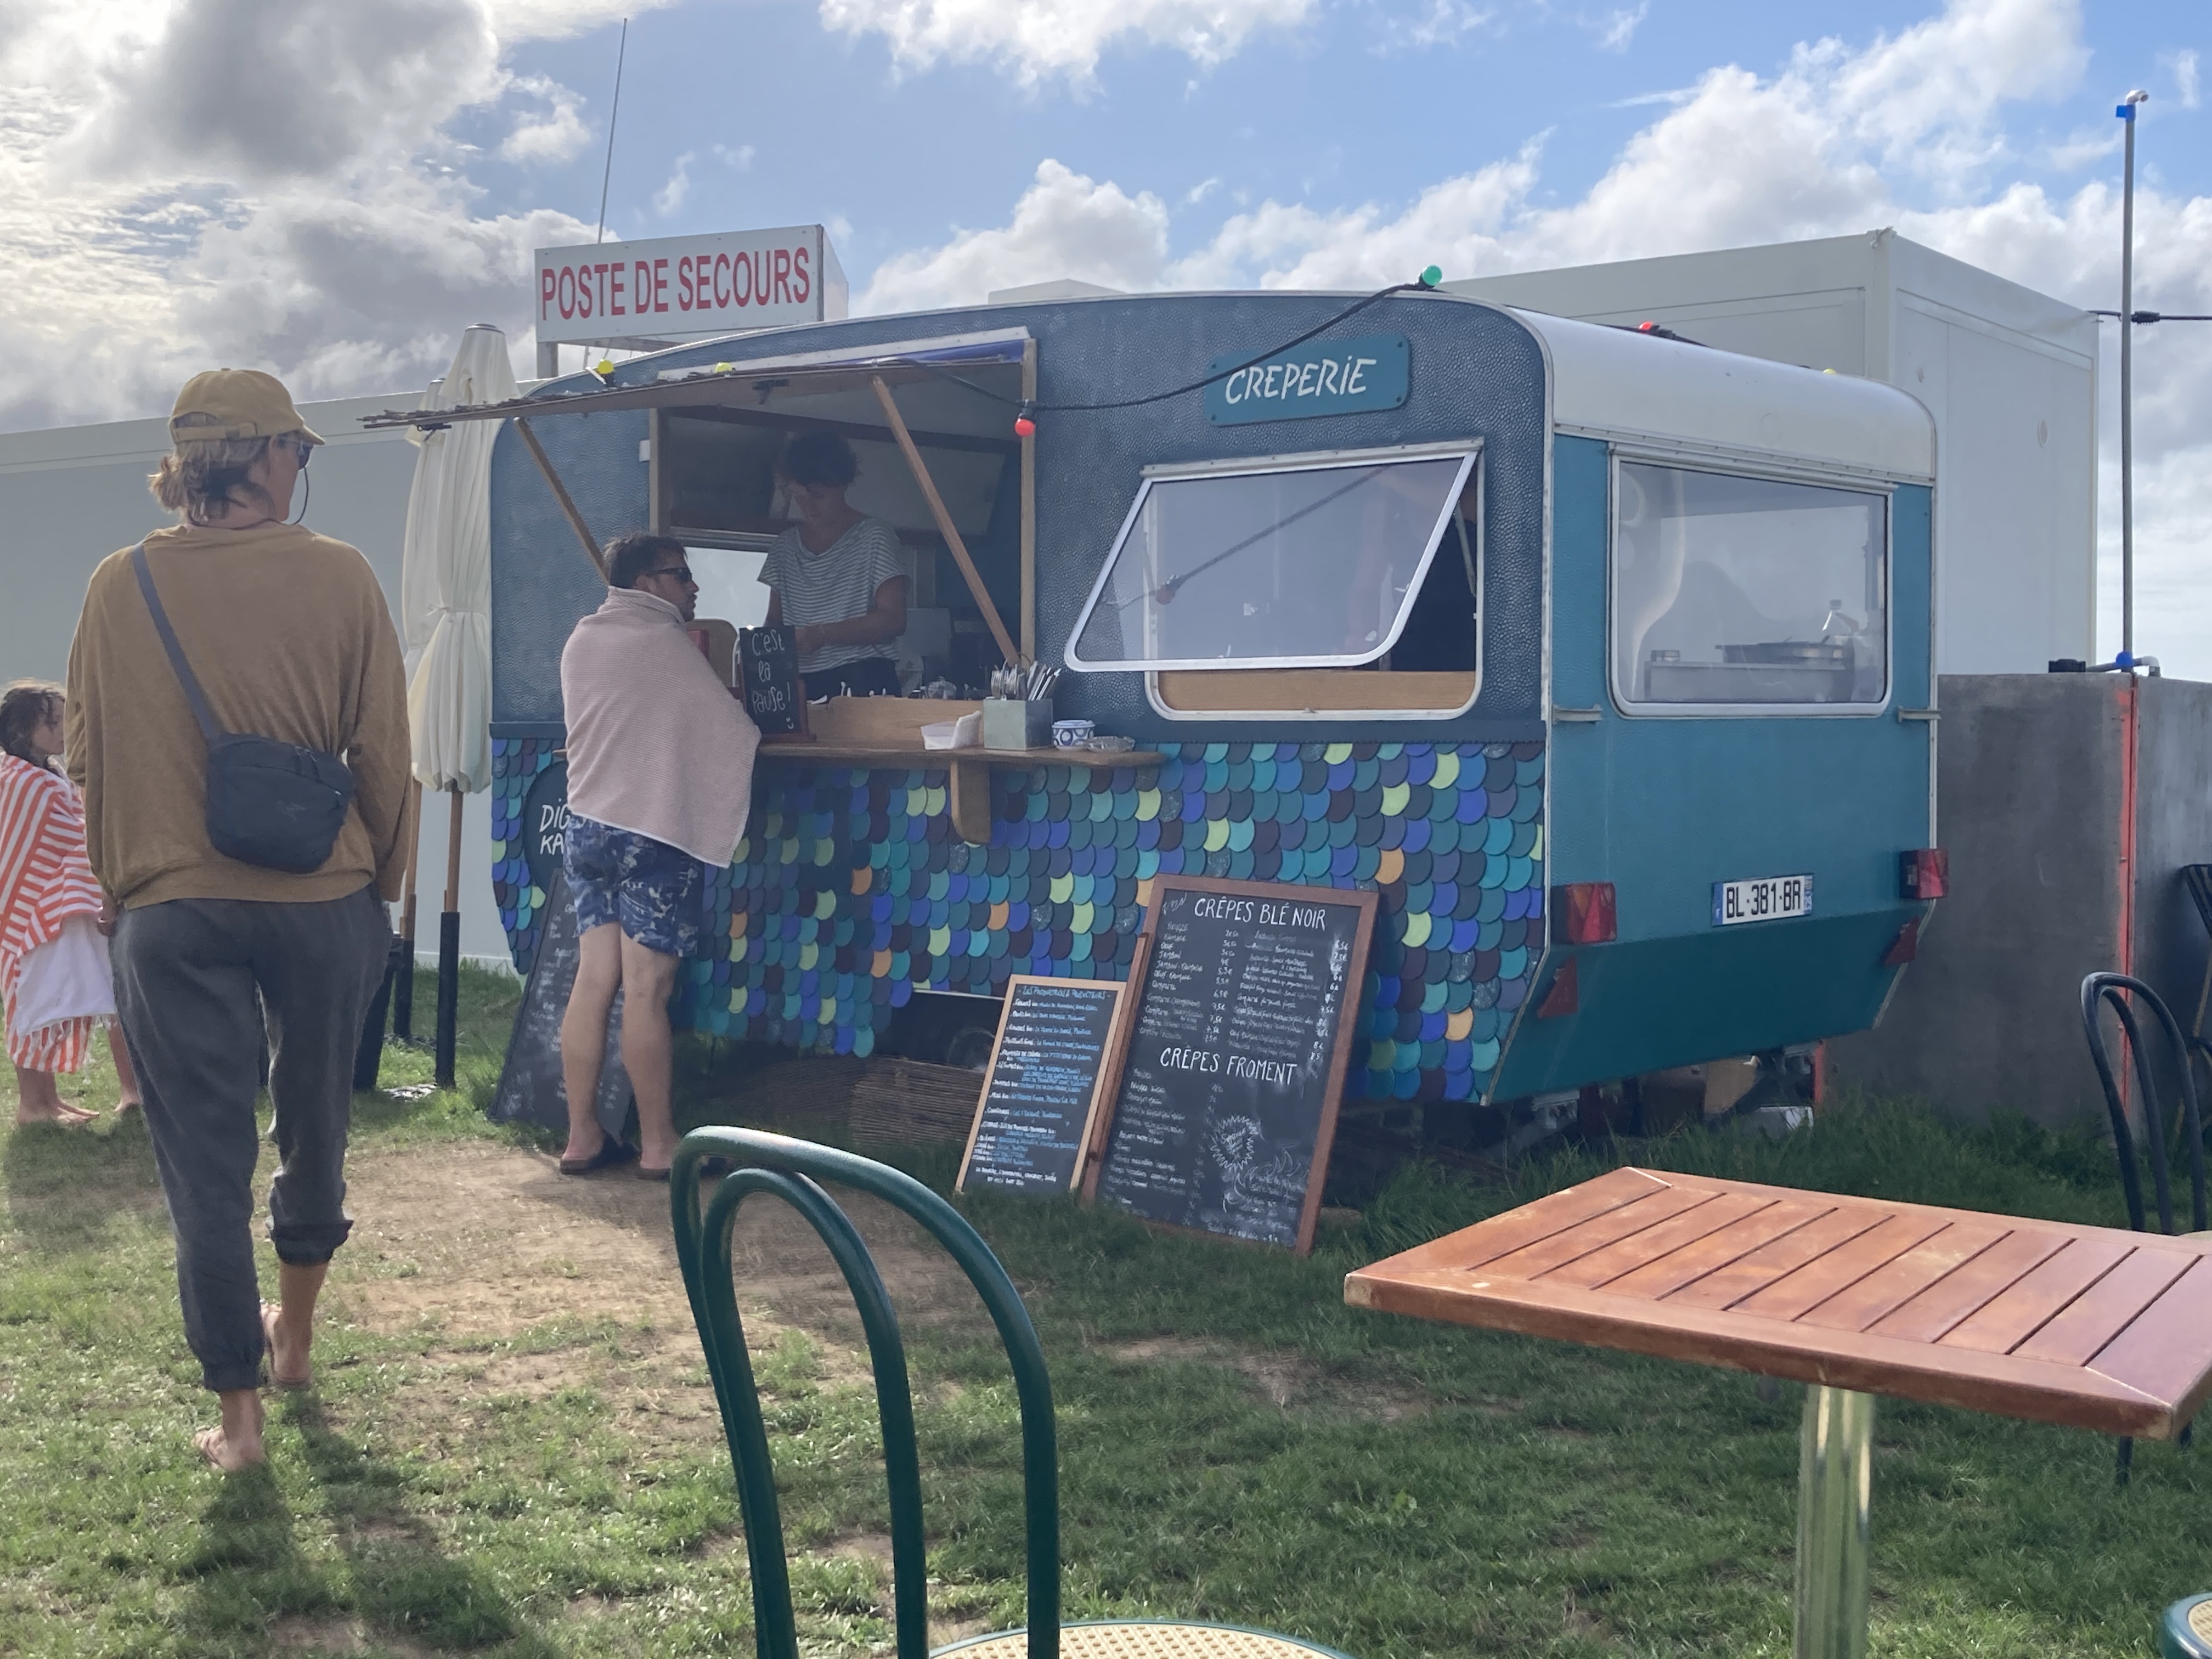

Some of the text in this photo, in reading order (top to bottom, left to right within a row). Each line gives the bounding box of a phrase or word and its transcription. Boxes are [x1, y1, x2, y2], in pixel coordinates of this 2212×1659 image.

[541, 246, 810, 320] POSTE DE SECOURS
[758, 660, 771, 682] la
[1194, 896, 1255, 923] CRÊPES
[1259, 901, 1290, 925] BLÉ
[1160, 1046, 1220, 1073] CRÊPES
[1227, 1056, 1298, 1086] FROMENT
